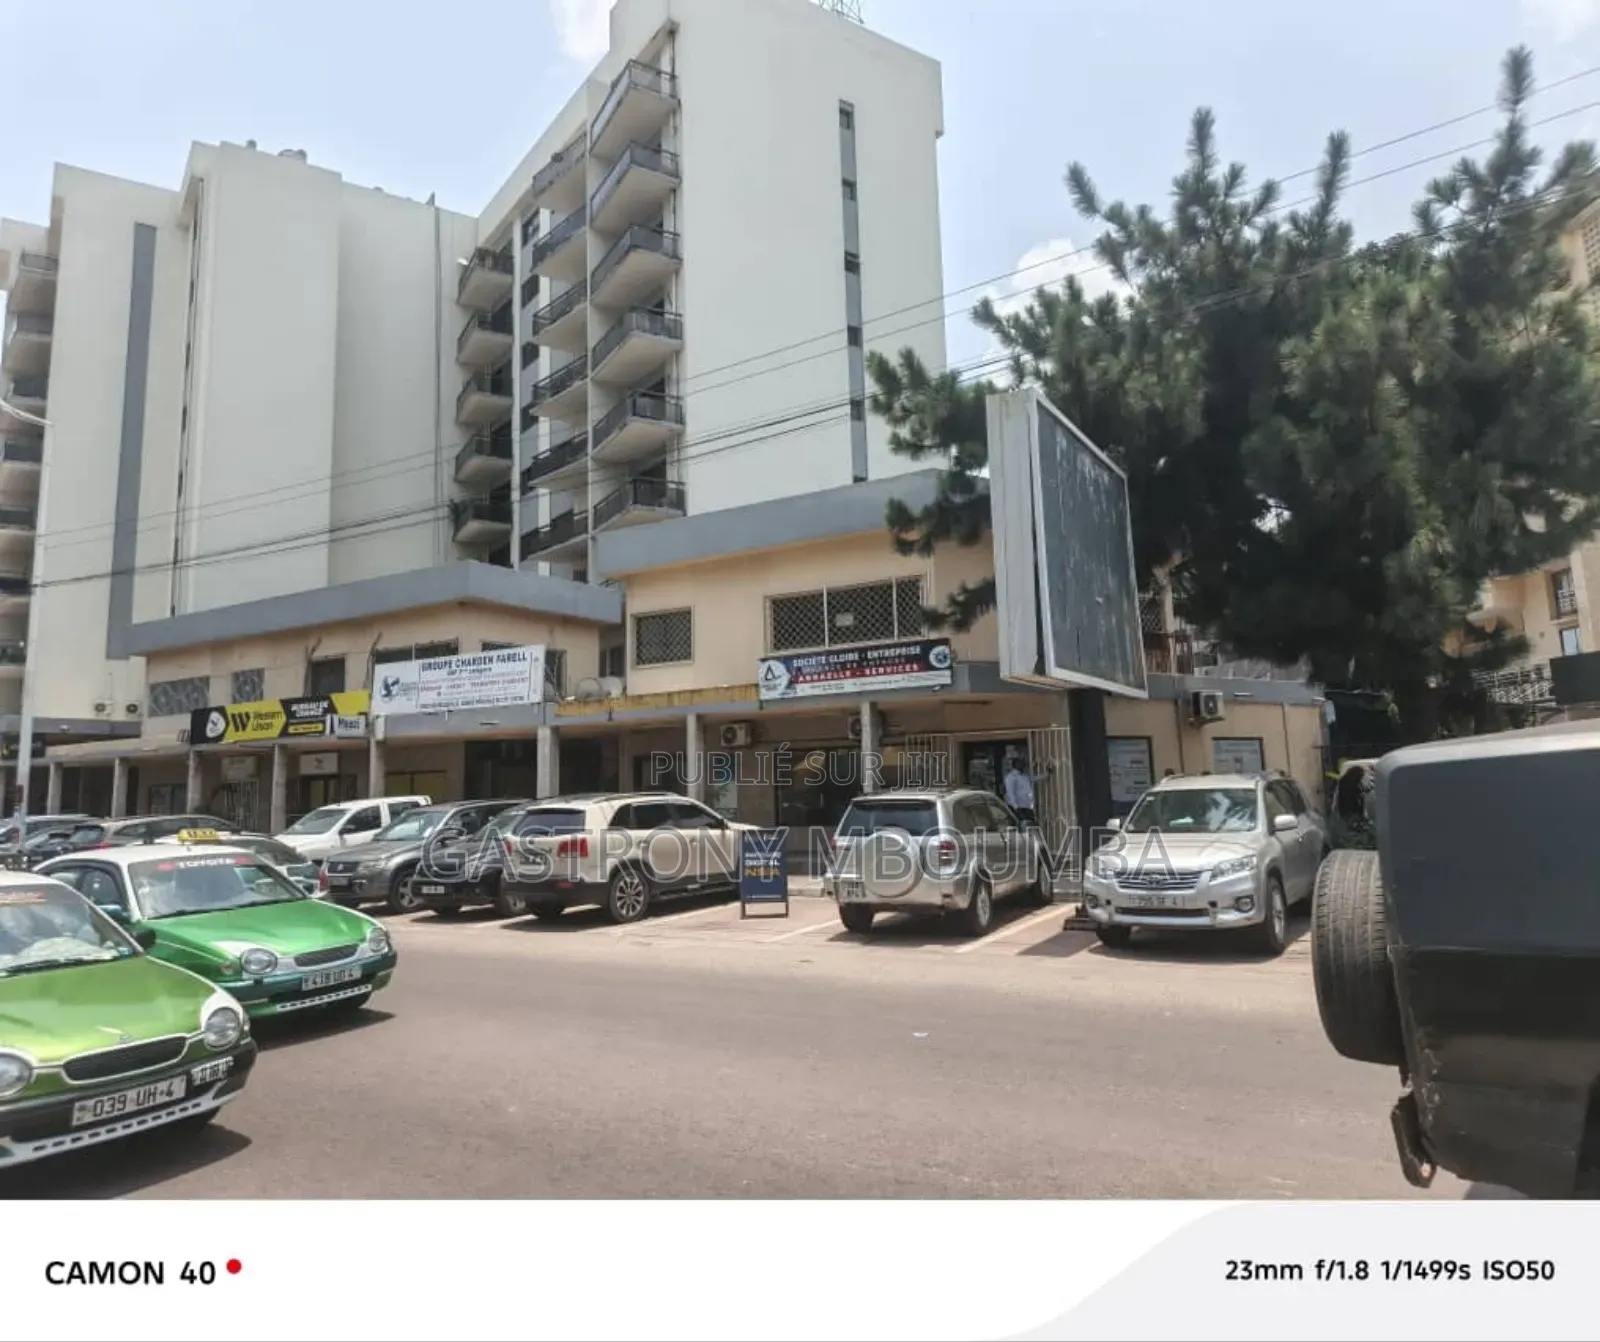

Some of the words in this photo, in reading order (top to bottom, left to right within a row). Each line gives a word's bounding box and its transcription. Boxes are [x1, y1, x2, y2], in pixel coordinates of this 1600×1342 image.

[422, 659, 453, 672] GROUPE
[253, 711, 282, 720] Western
[92, 1093, 127, 1118] 039
[135, 1081, 175, 1108] UH-4
